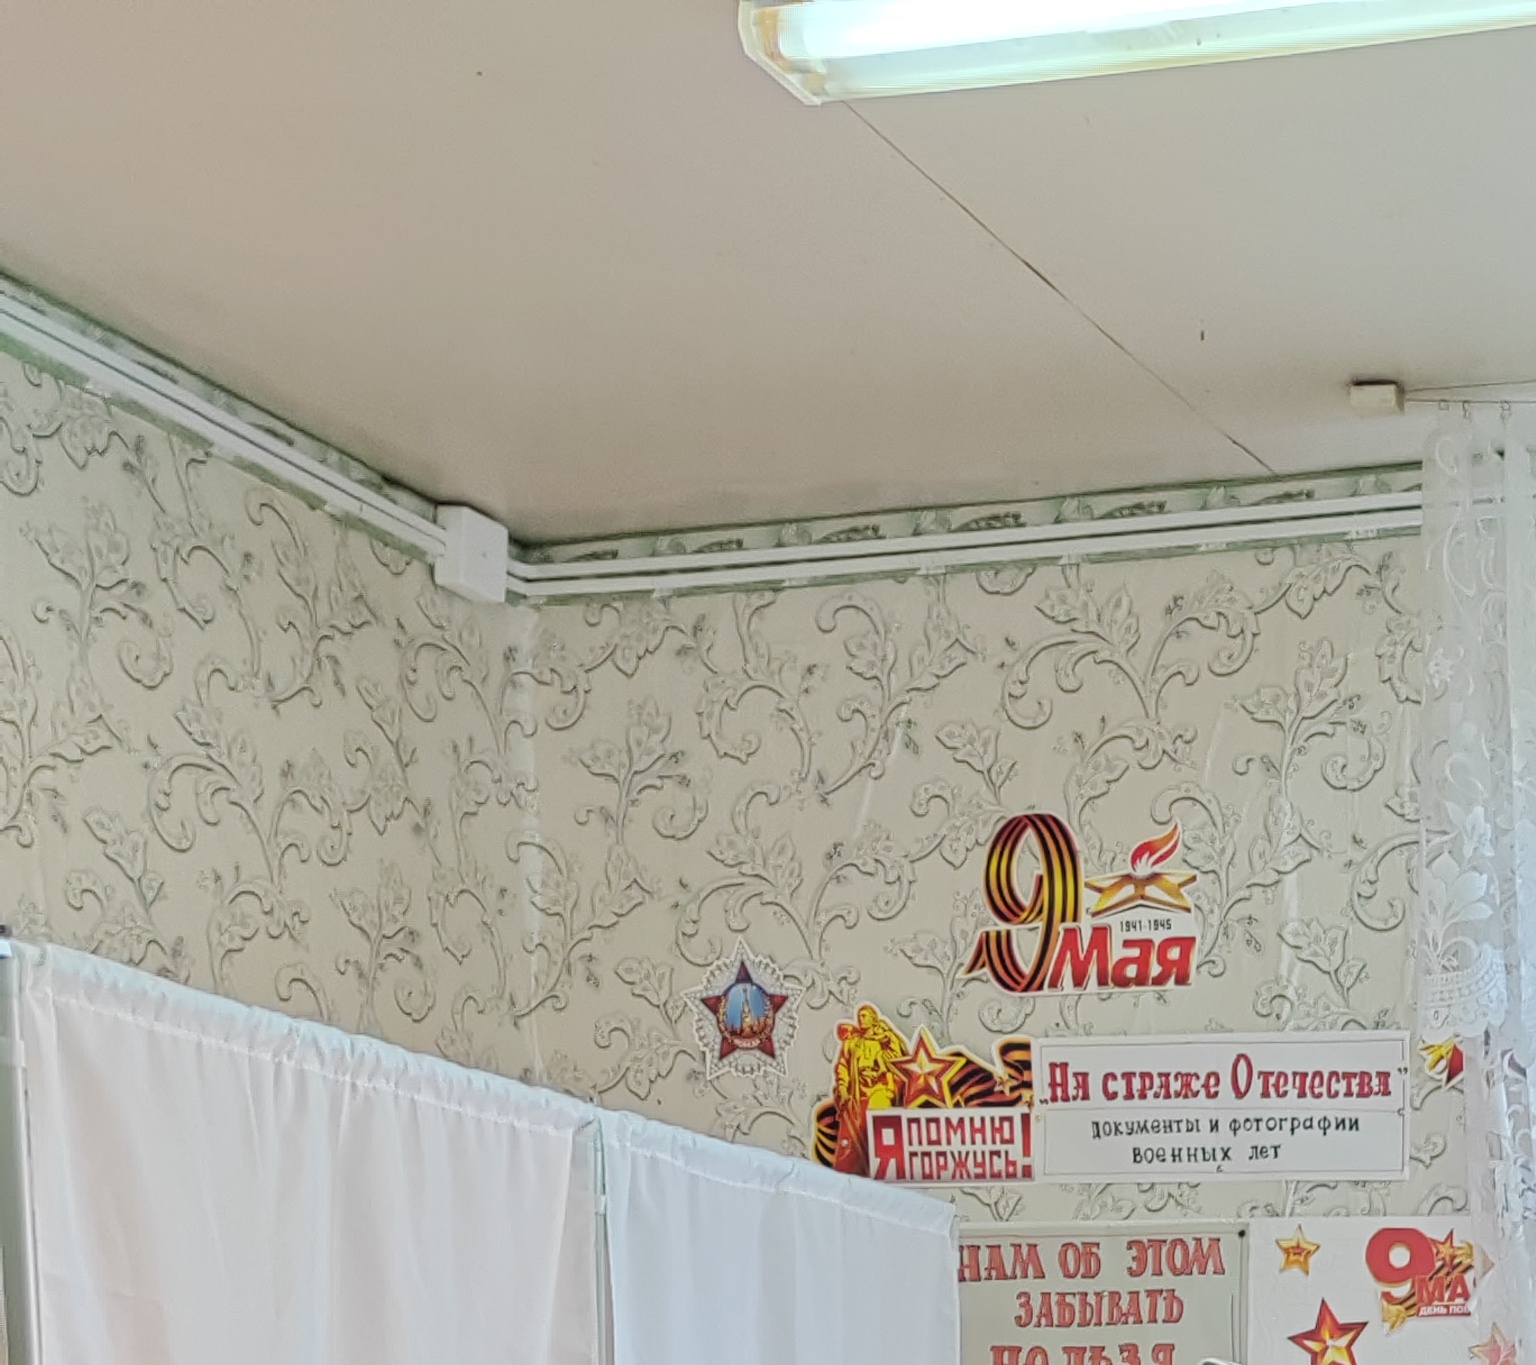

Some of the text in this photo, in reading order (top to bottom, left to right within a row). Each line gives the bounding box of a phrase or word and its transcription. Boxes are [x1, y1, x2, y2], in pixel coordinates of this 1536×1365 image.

[963, 812, 1197, 992] 9 Мая
[1102, 1068, 1220, 1100] страже
[1208, 1117, 1220, 1133] и
[1229, 1113, 1361, 1137] фотографии
[872, 1114, 1015, 1181] Я ПОМНЮ
[1132, 1143, 1282, 1164] военных лет
[959, 1237, 1226, 1282] НАМ ОБ ЭТОМ
[1365, 1227, 1471, 1305] 9 МА
[1014, 1288, 1184, 1328] ЗАБЫВАТЬ
